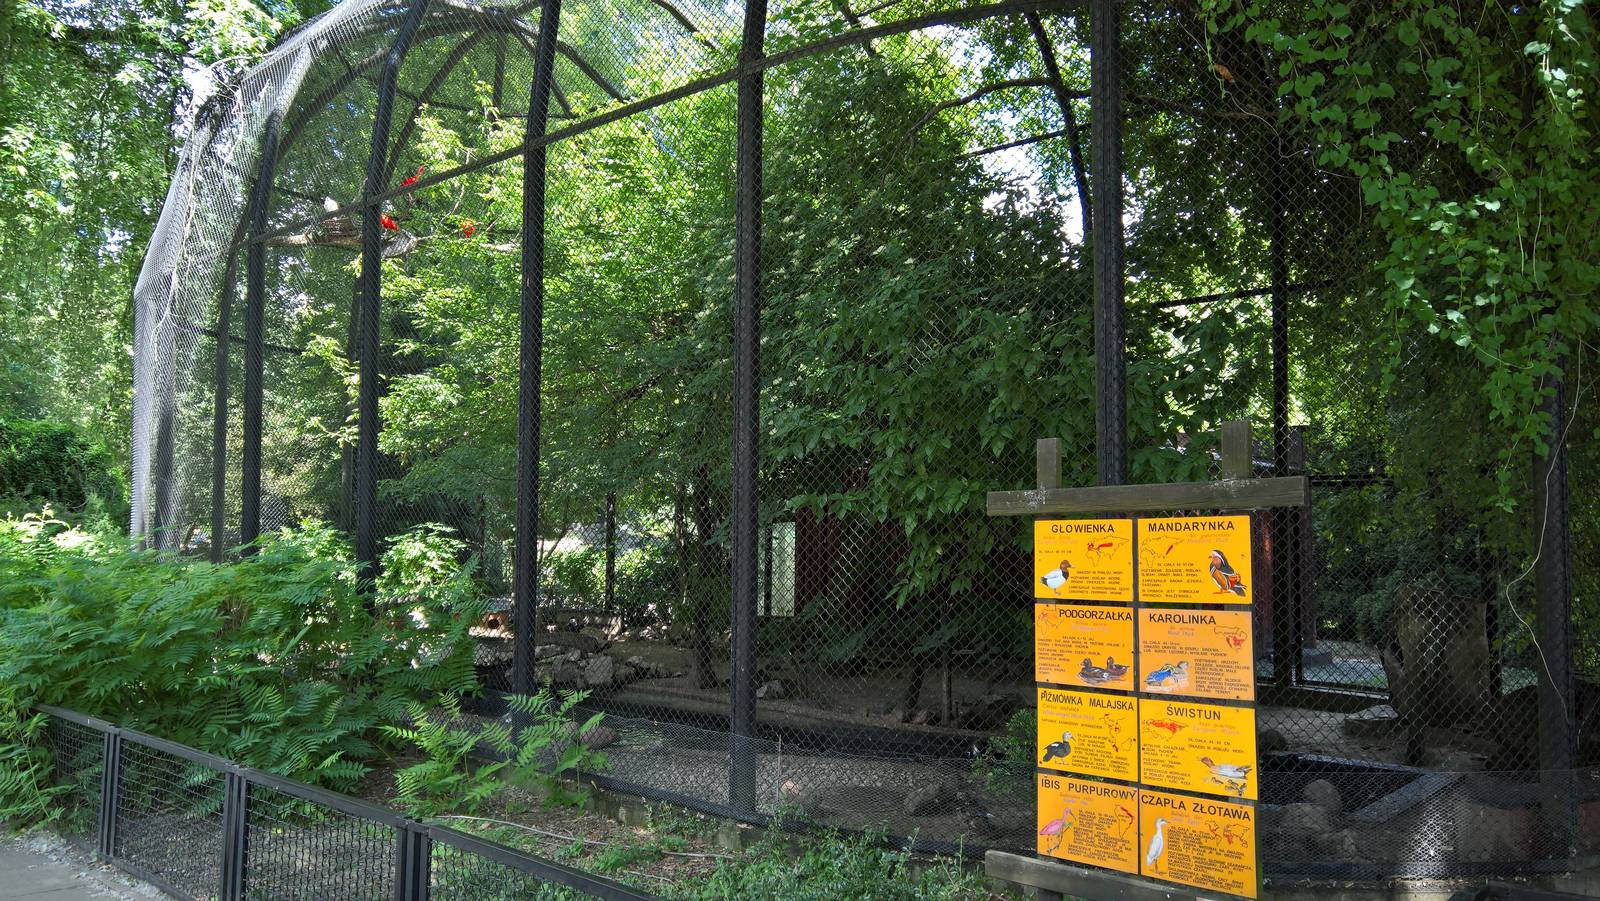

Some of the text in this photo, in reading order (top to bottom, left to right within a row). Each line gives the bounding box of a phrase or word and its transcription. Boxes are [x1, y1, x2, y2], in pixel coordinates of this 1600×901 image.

[1051, 524, 1115, 533] GŁOWIENKA
[1148, 521, 1235, 532] MANDARYNKA
[1059, 609, 1133, 621] PODGORZAŁKA
[1149, 613, 1217, 625] KAROLINKA
[1089, 698, 1135, 711] MALAJSKA
[1166, 704, 1221, 720] ŚWISTUN
[1041, 778, 1061, 789] IBIS
[1068, 783, 1136, 799] PURPUROWY
[1141, 795, 1187, 810] CZAPLA
[1192, 803, 1251, 821] ZŁOTAWA
